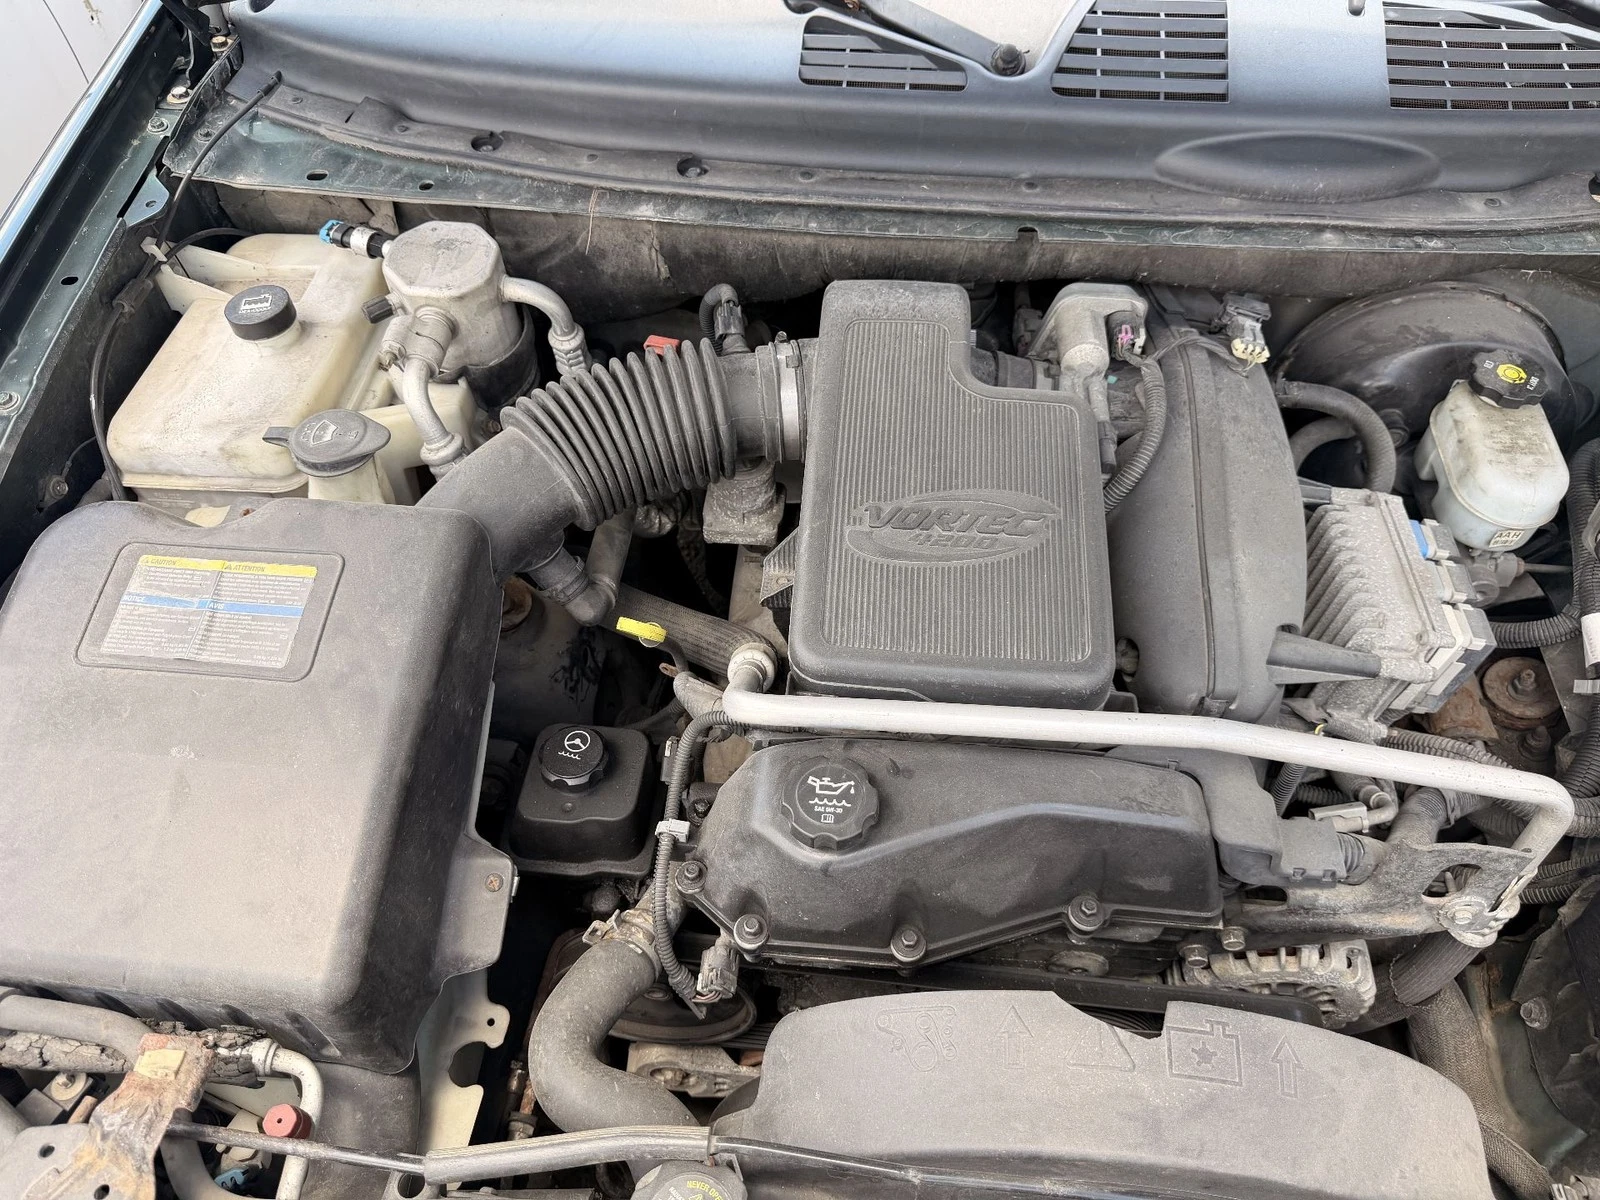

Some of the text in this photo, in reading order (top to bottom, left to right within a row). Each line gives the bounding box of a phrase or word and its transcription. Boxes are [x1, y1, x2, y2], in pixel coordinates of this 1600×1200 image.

[864, 504, 1045, 538] VORTEC
[1494, 531, 1521, 539] AAH
[908, 532, 998, 549] 4200
[150, 558, 177, 566] CAUTION
[233, 564, 266, 573] ATTENTION
[209, 602, 225, 610] AVIS
[687, 1180, 724, 1200] NEVER OPE
